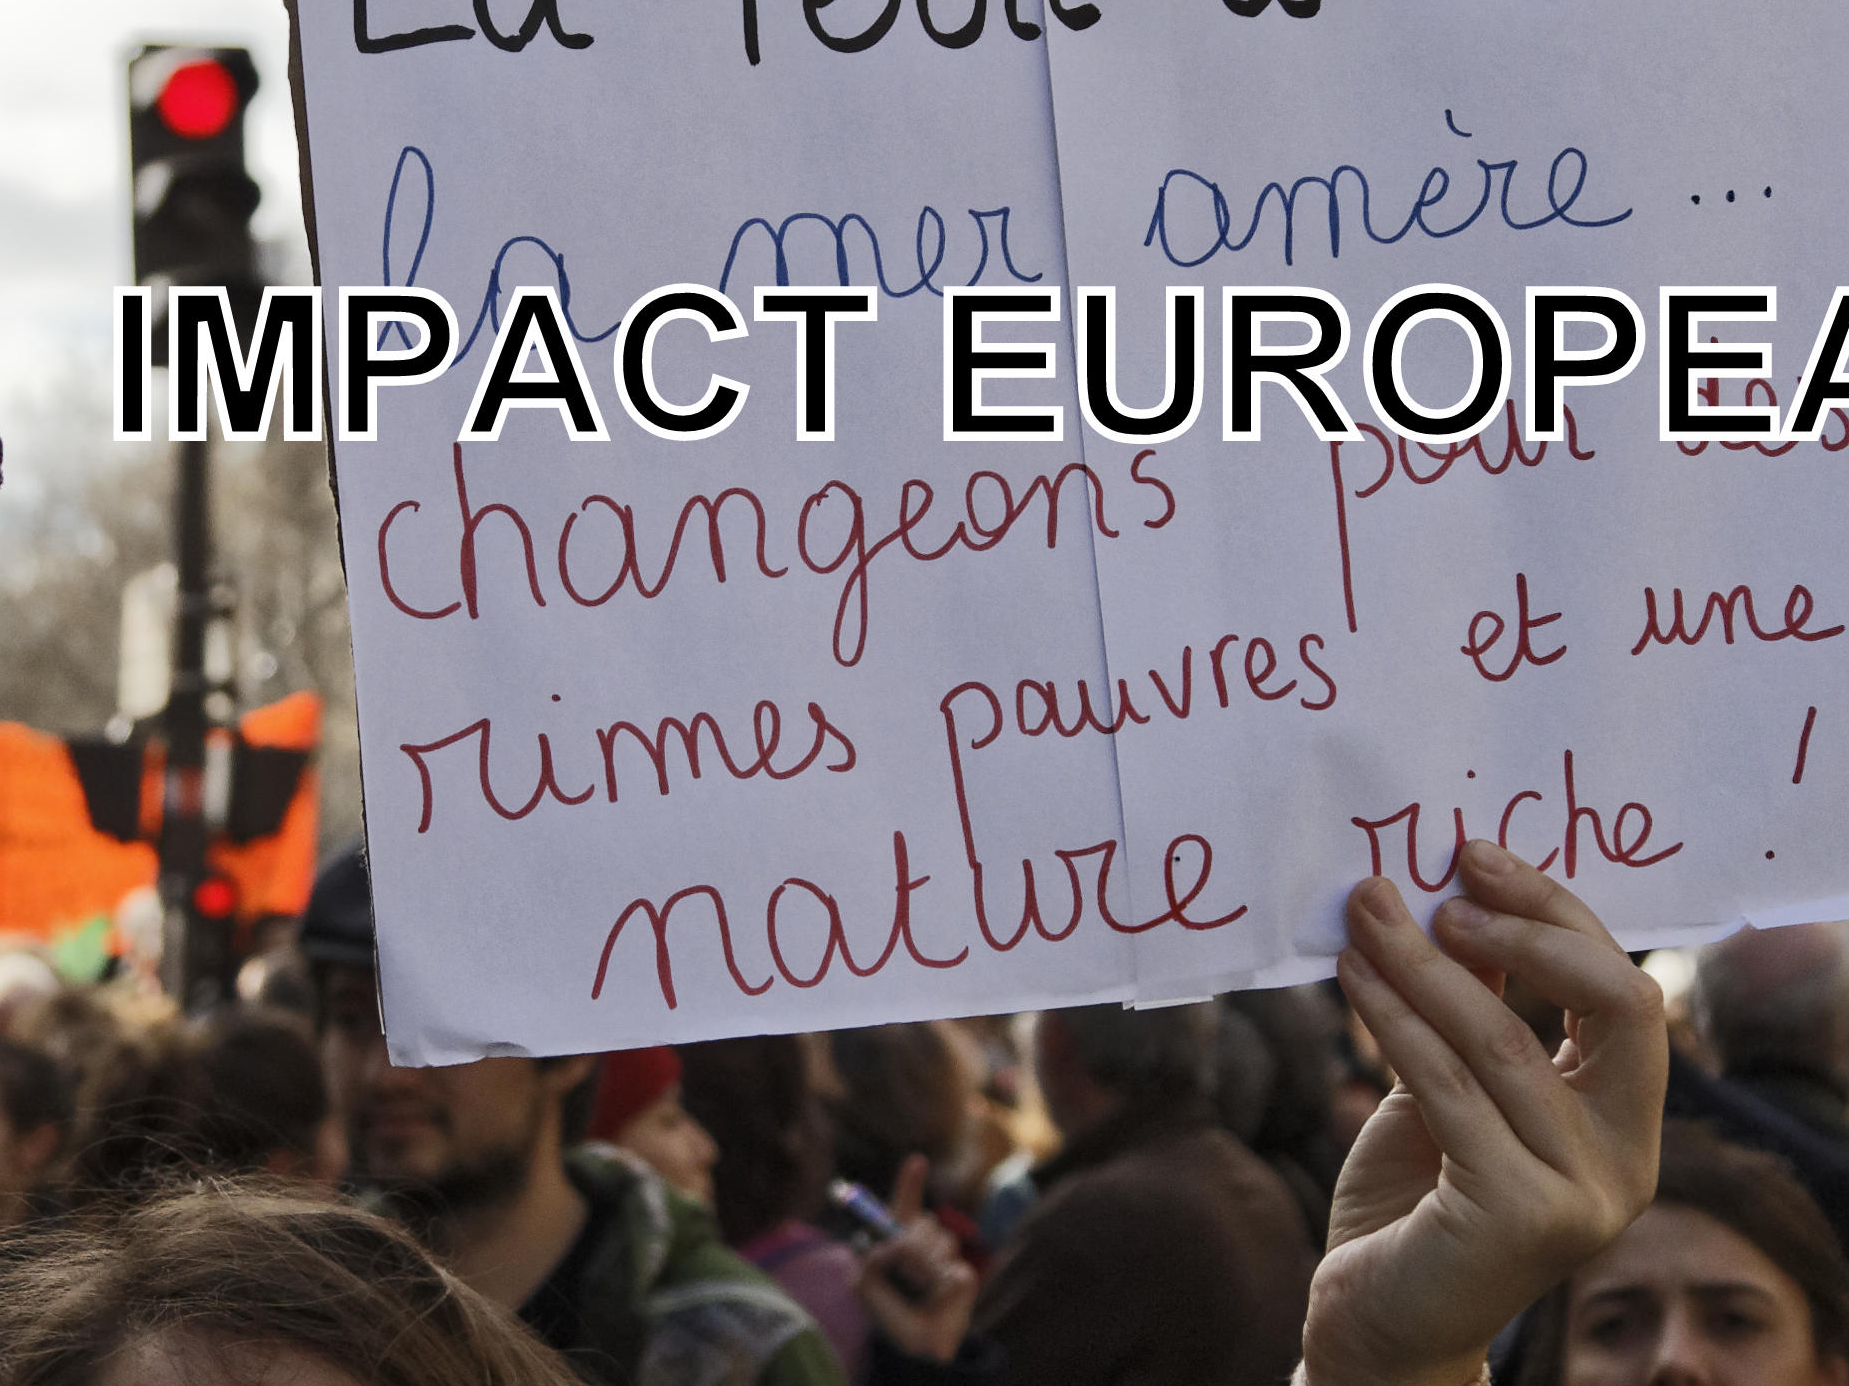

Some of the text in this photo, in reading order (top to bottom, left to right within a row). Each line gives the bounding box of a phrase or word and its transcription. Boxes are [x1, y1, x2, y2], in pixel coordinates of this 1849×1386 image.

[719, 203, 1045, 305] mer
[376, 441, 1178, 667] changeons
[398, 572, 1846, 869] rimes pauvres et une
[588, 828, 1249, 1011] nature
